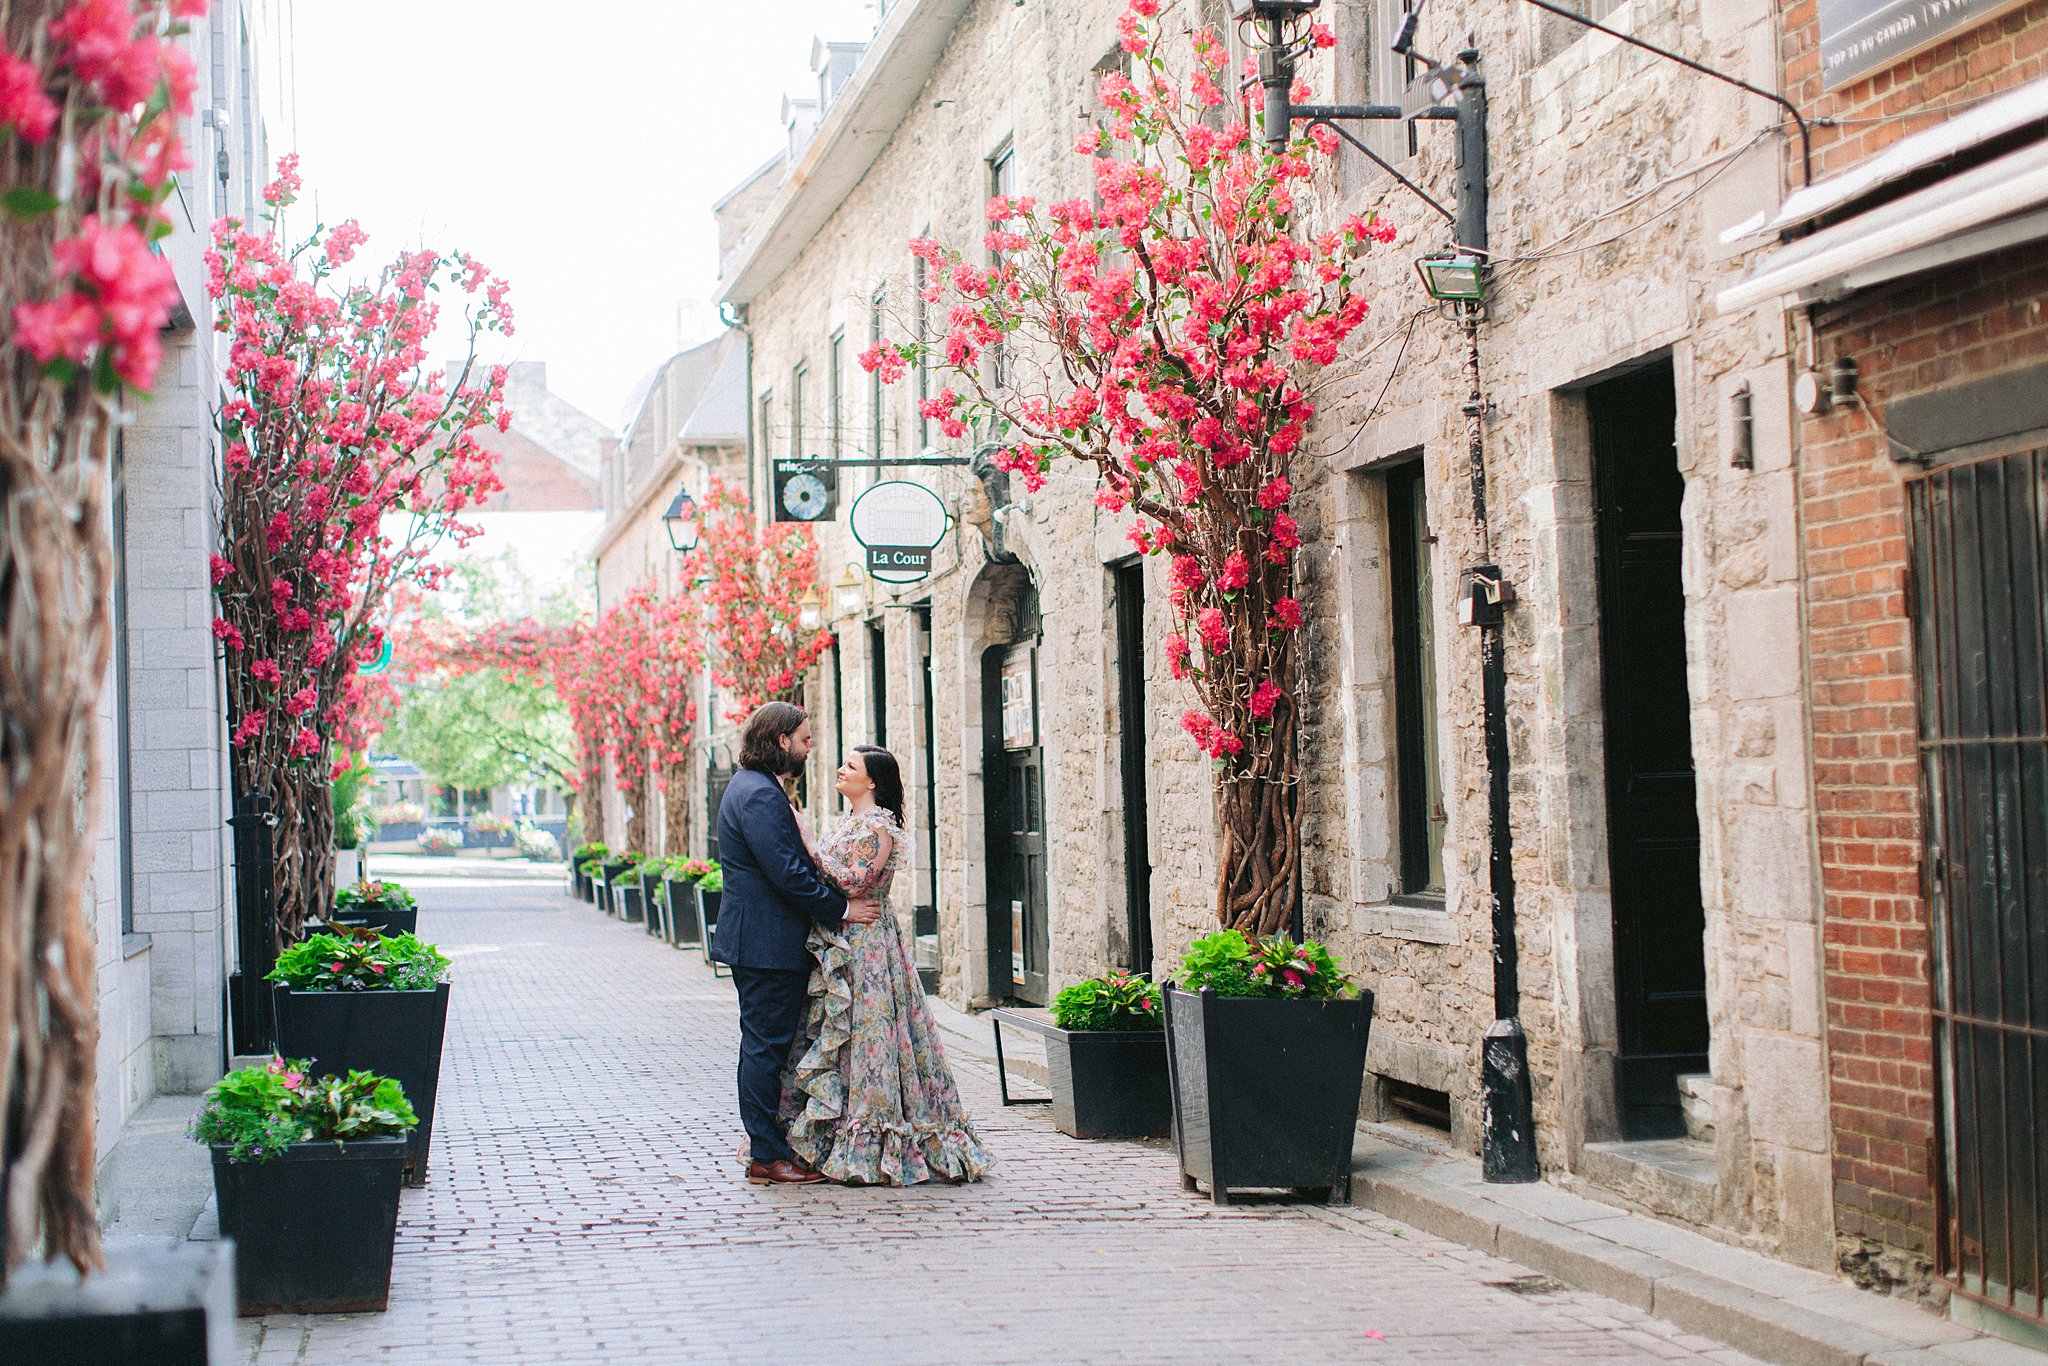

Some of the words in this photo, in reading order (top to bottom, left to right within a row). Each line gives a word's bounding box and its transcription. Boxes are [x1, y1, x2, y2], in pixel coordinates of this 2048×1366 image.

[1828, 50, 1846, 67] TOP
[1861, 36, 1875, 53] AU
[1876, 14, 1917, 44] CANADA
[872, 550, 889, 564] La
[893, 551, 927, 565] Cour
